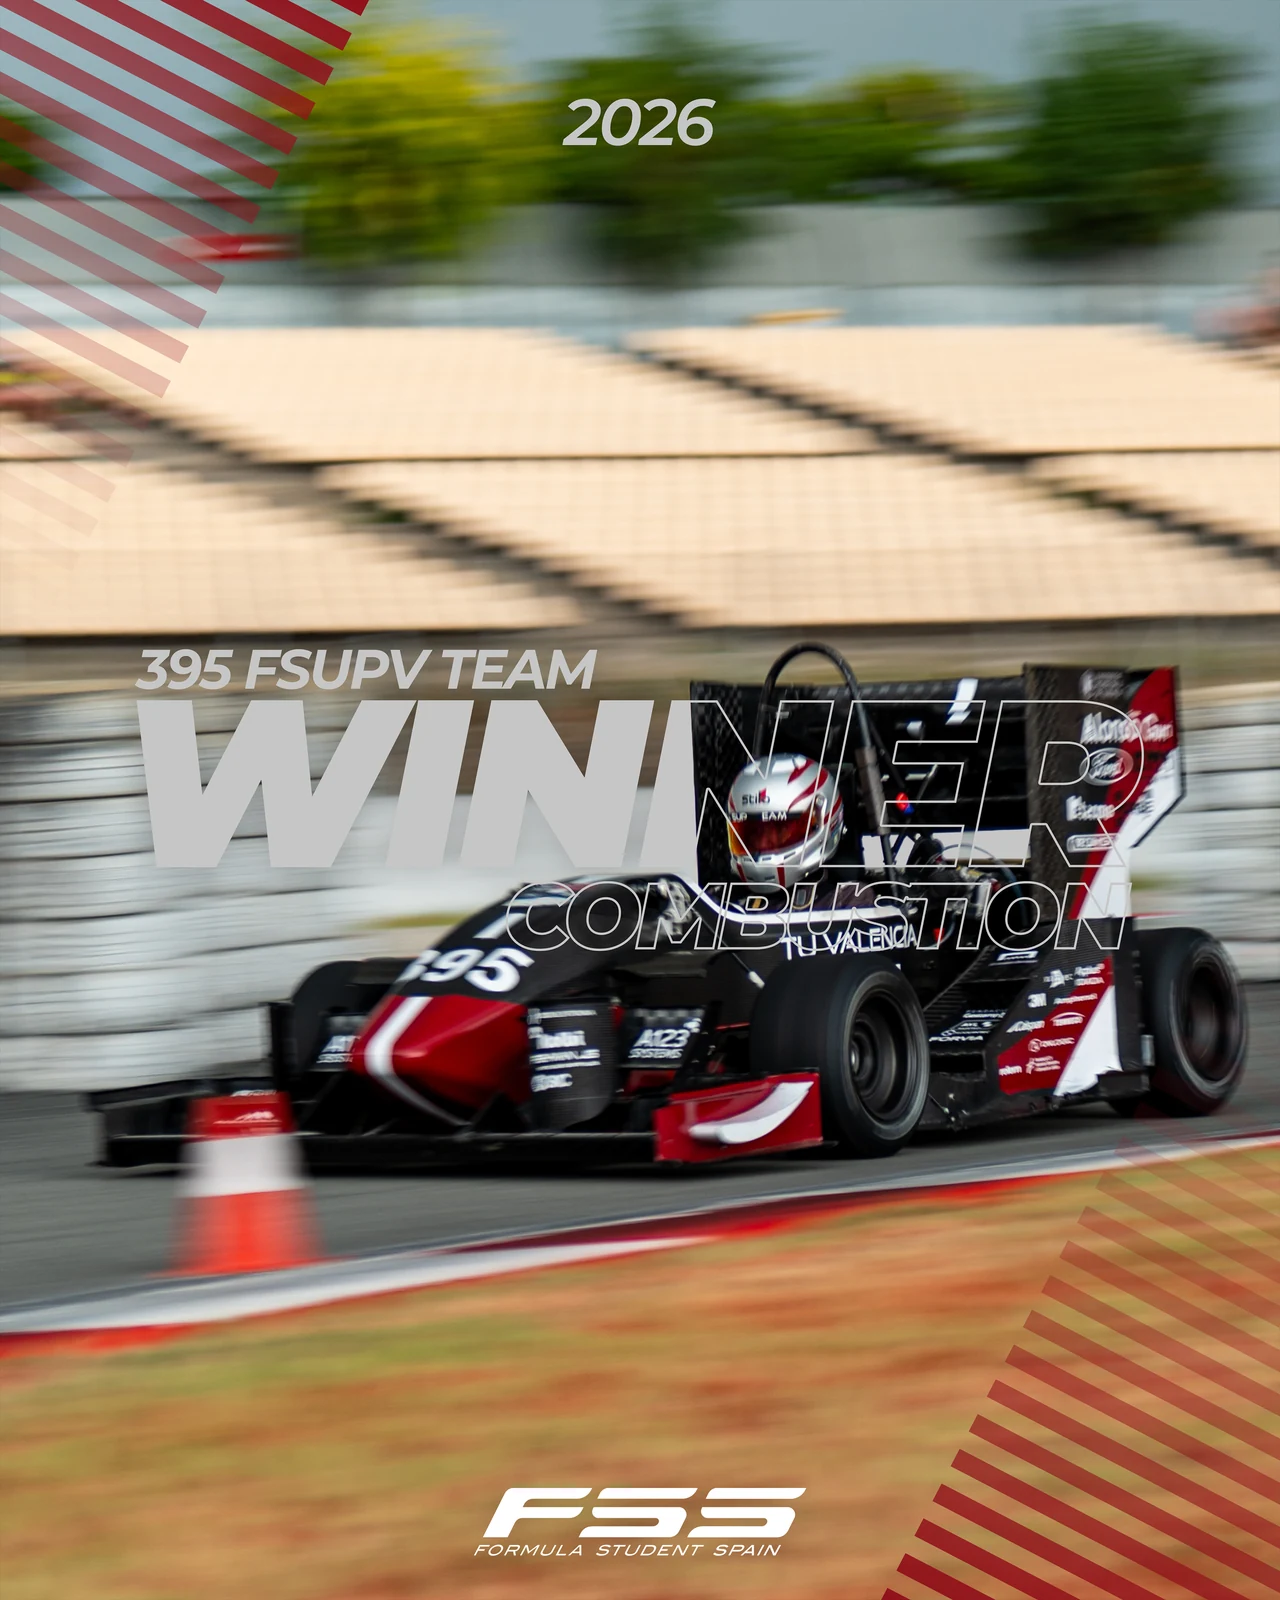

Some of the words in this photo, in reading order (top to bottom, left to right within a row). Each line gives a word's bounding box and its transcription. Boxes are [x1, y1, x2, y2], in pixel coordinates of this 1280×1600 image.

[780, 934, 817, 960] TU
[823, 924, 918, 955] VALENCIA
[1028, 993, 1047, 1008] 3M
[633, 1029, 691, 1048] A123
